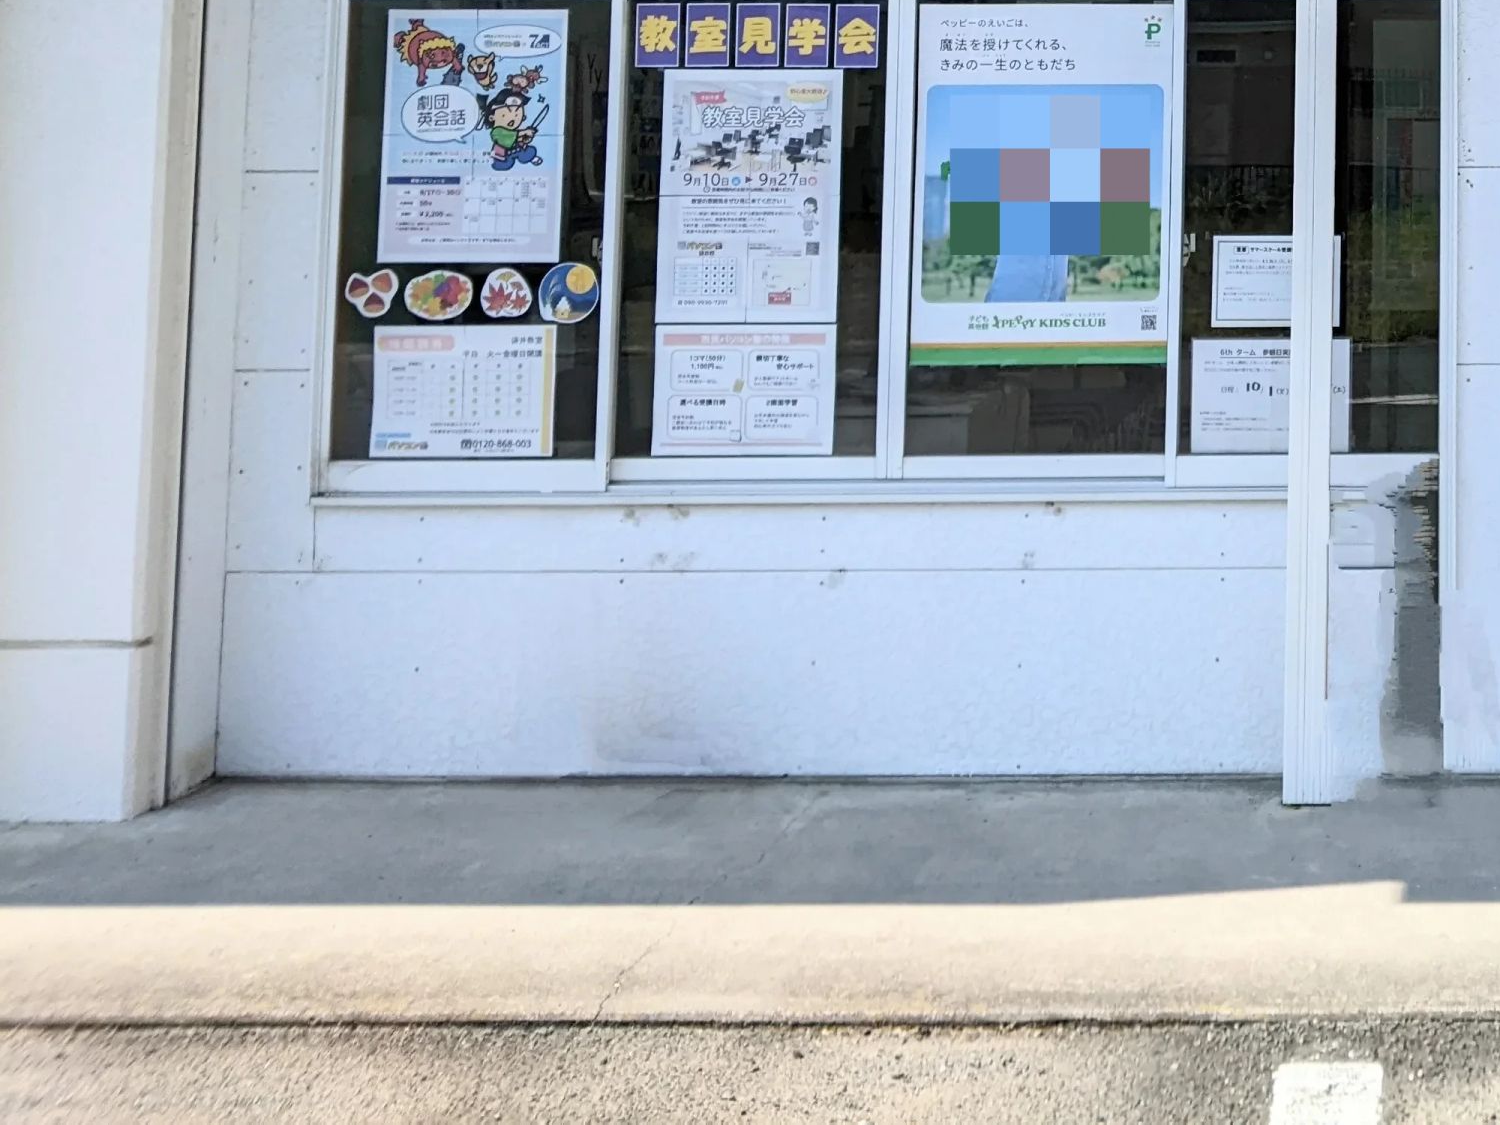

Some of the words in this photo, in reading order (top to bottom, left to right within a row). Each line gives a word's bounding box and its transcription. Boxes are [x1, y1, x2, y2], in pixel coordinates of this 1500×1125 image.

[639, 15, 877, 56] 教室見学会
[939, 38, 1067, 52] 魔法を授けてくれる、
[940, 58, 1076, 72] きみの一生のともだち
[417, 93, 449, 111] 劇団
[416, 109, 466, 128] 英会話
[702, 105, 805, 128] 教室見学会
[1039, 318, 1070, 328] KIDS
[1072, 318, 1106, 328] CLUB
